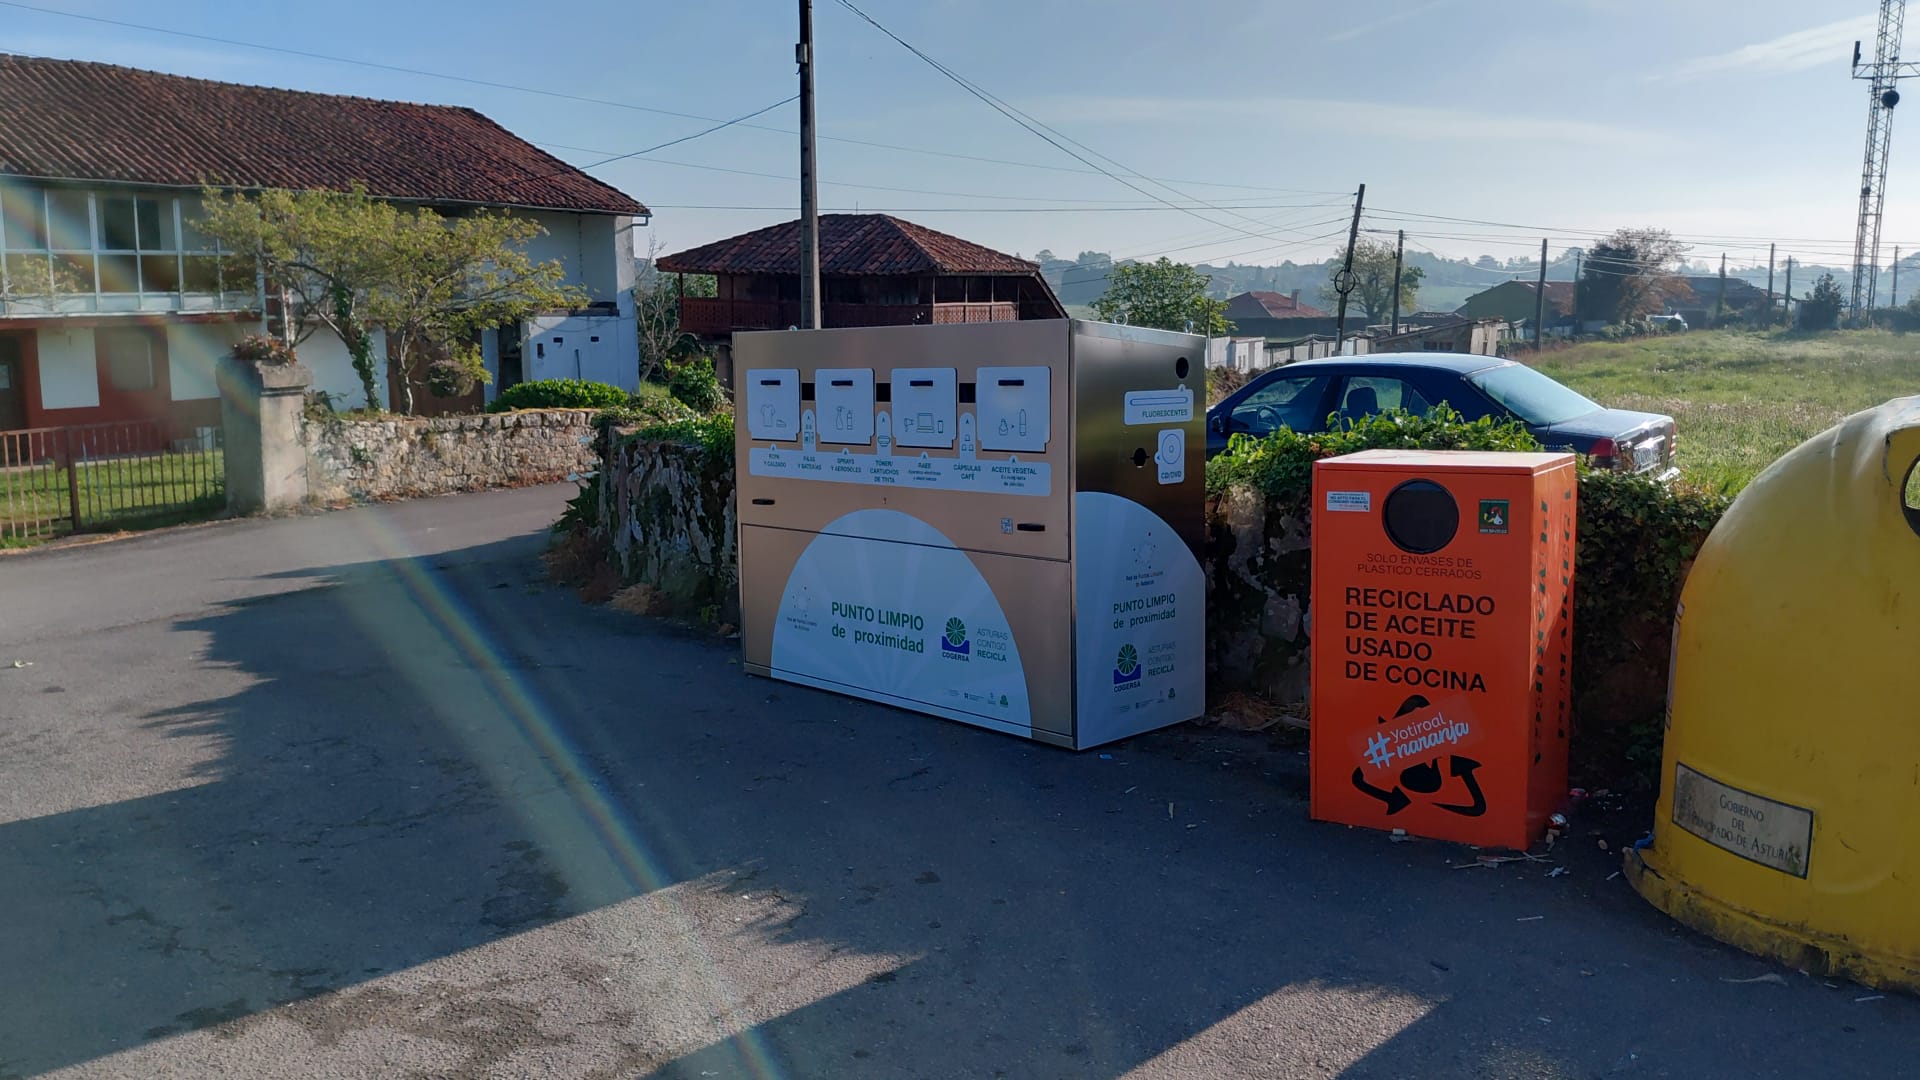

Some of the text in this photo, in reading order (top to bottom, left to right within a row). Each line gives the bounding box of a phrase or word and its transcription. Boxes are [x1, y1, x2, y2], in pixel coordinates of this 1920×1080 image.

[1142, 408, 1188, 418] FLUORESCENTES
[837, 457, 855, 465] SPRAYS
[869, 467, 899, 476] CARTUCHOS
[991, 465, 1038, 476] ACEITE VEGETAL
[1367, 553, 1473, 568] SOLO ENVASES DE
[1357, 563, 1482, 580] PLASTICO CERRADOS
[1113, 592, 1176, 614] PUNTO LIMPIO
[1345, 586, 1495, 616] RECICLADO
[831, 601, 875, 623] PUNTO
[878, 606, 924, 632] LIMPIO
[1113, 608, 1176, 630] de proximidad
[1345, 610, 1476, 640] DE ACEITE
[831, 623, 924, 654] de proximidad
[976, 627, 1009, 641] ASTURIAS
[976, 638, 1007, 652] CONTIGO
[1345, 635, 1433, 662] USADO
[941, 651, 970, 662] COGERSA
[976, 650, 1007, 663] RECICLA
[1148, 664, 1175, 677] RECICLA
[1345, 660, 1487, 693] DE COCINA
[1113, 681, 1141, 693] COGERSA
[1396, 719, 1470, 759] naranja
[1731, 817, 1745, 832] DEL
[1736, 834, 1747, 849] DE
